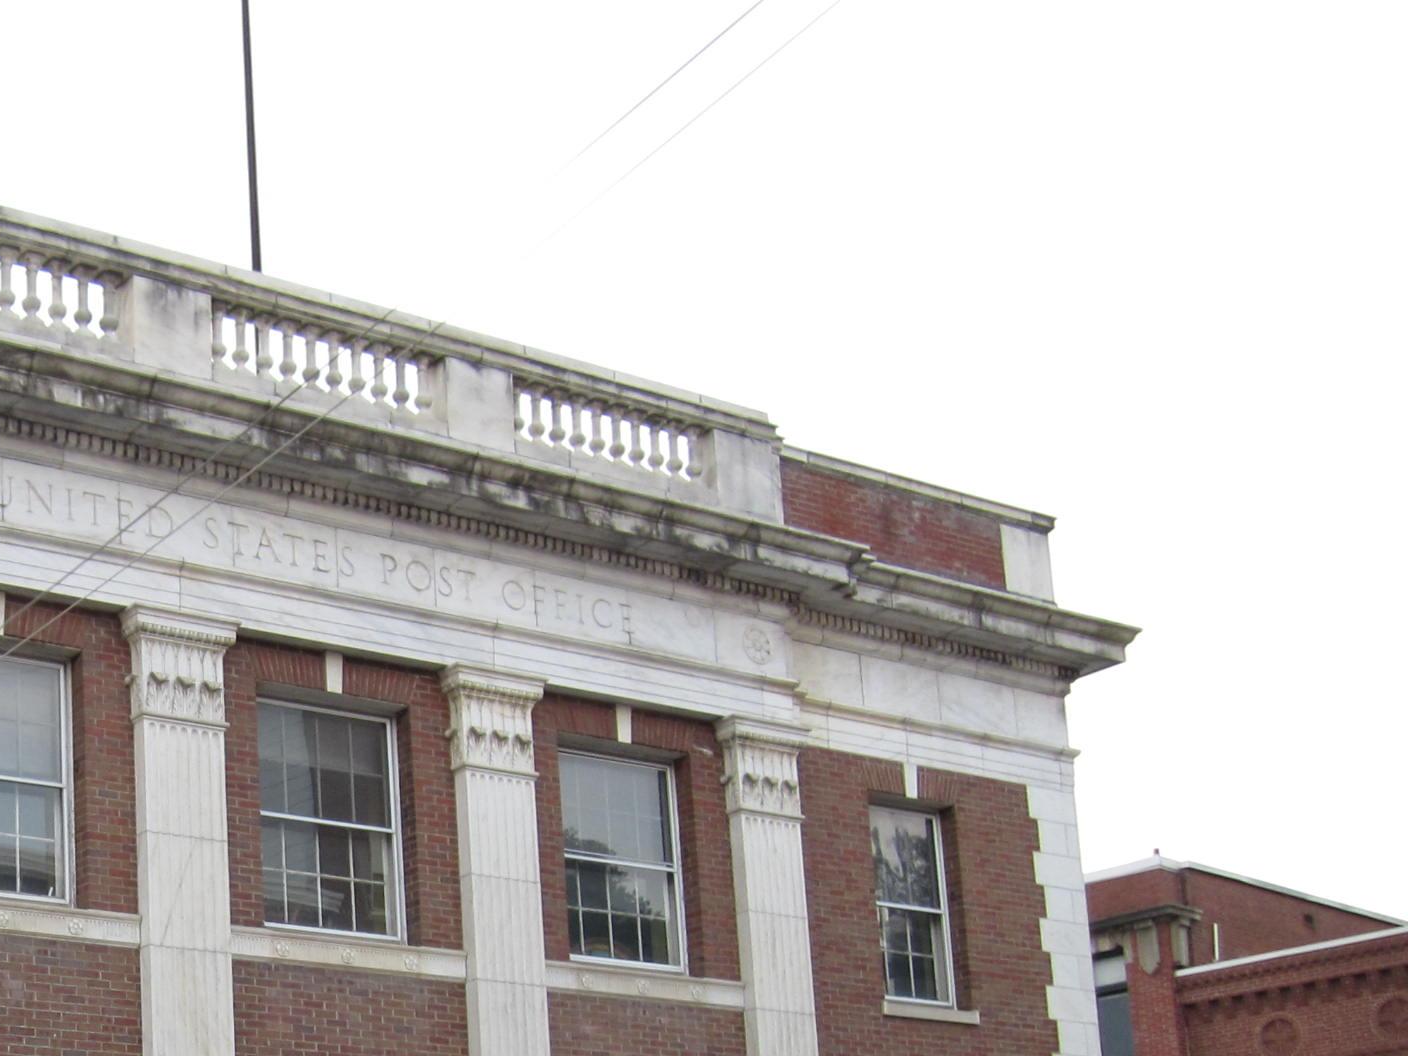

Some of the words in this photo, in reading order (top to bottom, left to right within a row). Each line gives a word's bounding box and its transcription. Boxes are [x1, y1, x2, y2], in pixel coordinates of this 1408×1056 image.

[202, 517, 355, 578] STATES
[379, 552, 475, 601] POST
[501, 579, 634, 634] OFFICE
